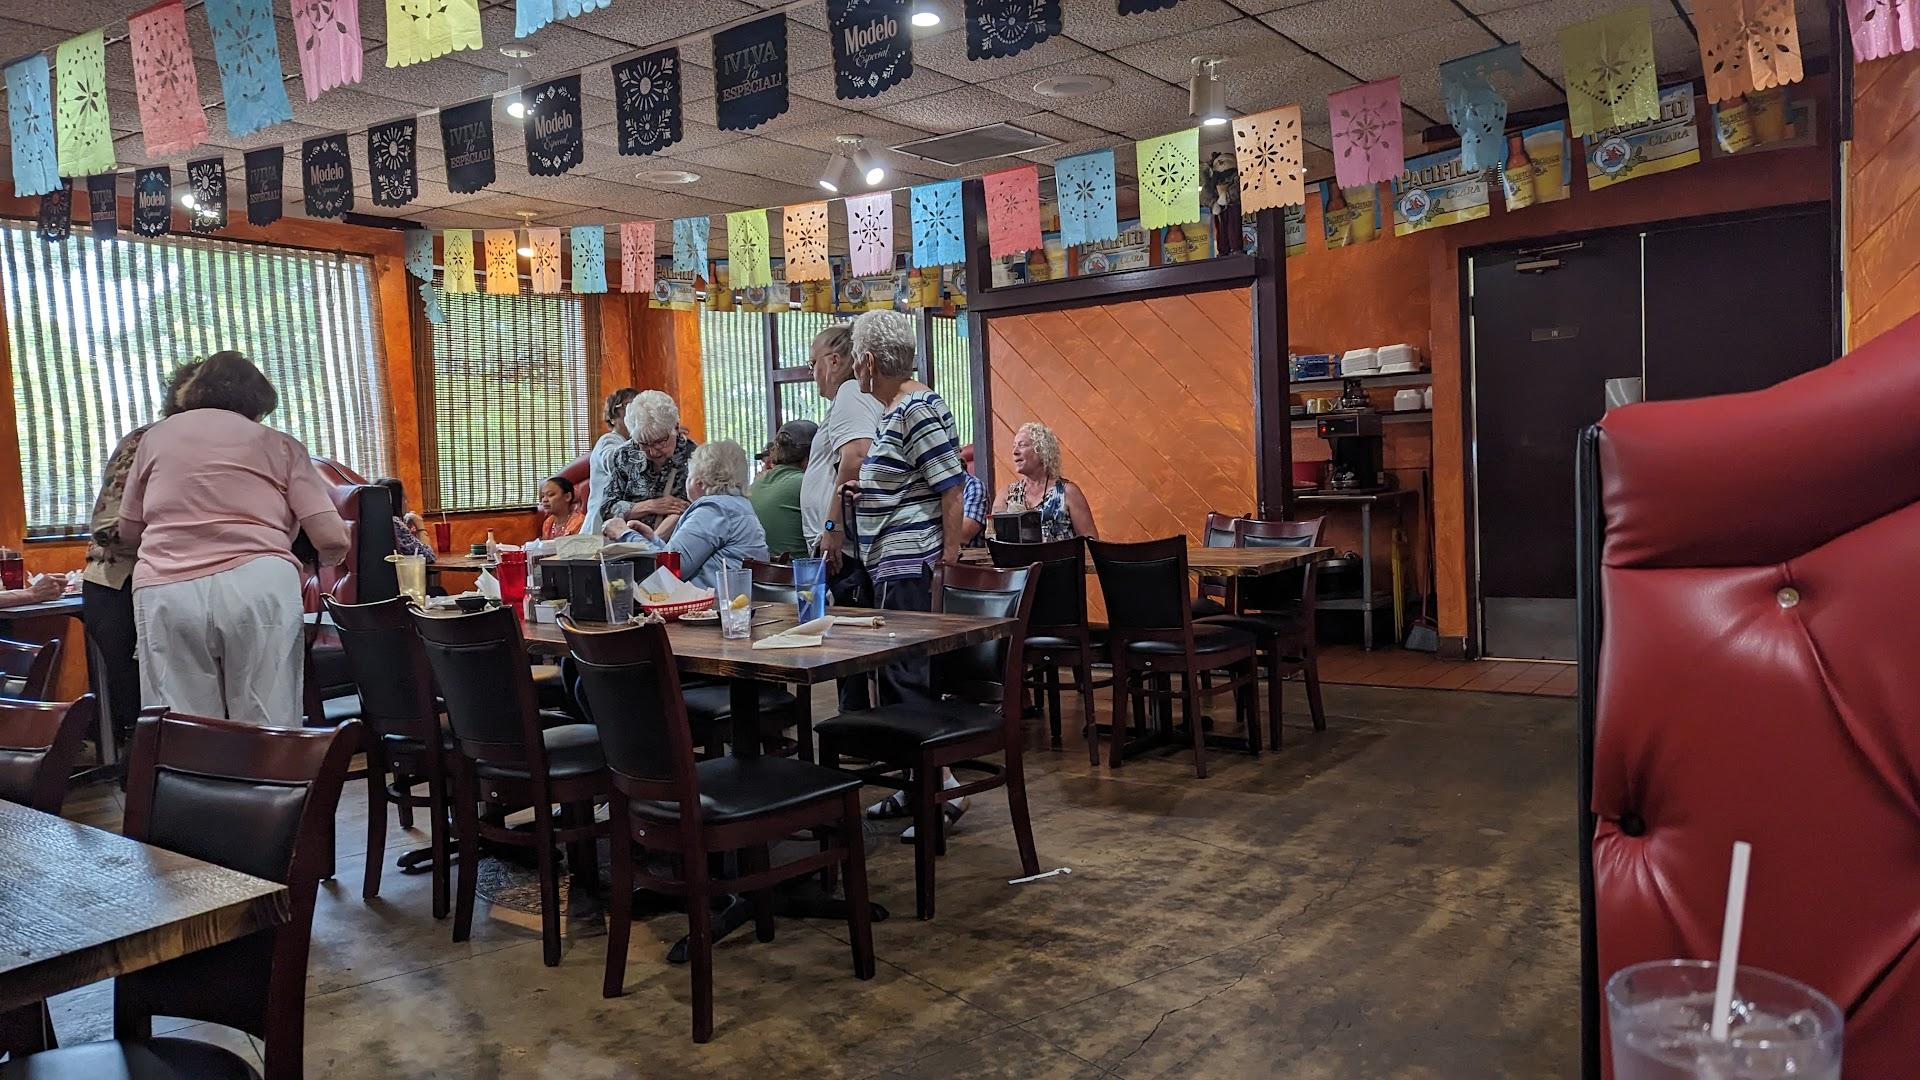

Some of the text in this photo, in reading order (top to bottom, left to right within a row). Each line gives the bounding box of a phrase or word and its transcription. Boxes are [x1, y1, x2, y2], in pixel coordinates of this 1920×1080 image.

[843, 14, 897, 57] Modelo
[853, 44, 892, 69] Especial
[722, 72, 783, 102] ESPECIAL!
[534, 108, 574, 141] Modelo
[1648, 128, 1691, 147] CLARA
[310, 162, 345, 186] Modelo
[1394, 159, 1481, 193] PACIFIC
[139, 190, 166, 208] Modelo
